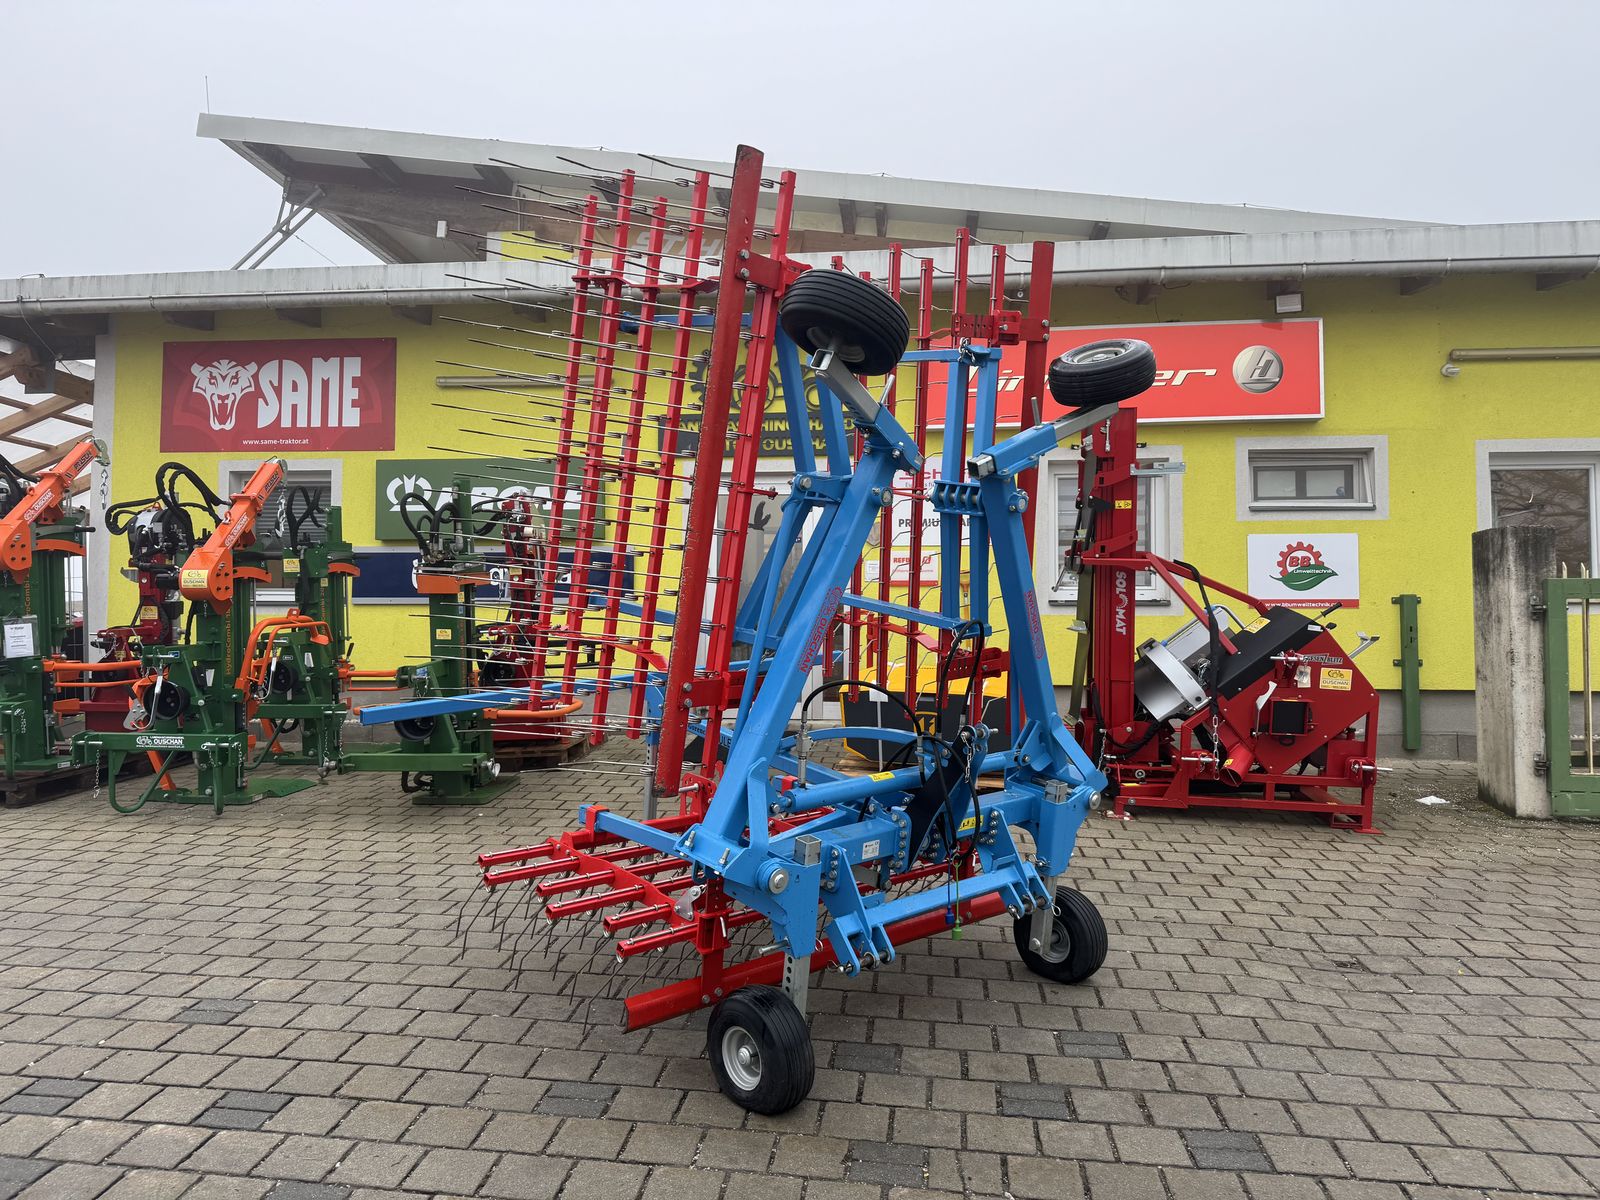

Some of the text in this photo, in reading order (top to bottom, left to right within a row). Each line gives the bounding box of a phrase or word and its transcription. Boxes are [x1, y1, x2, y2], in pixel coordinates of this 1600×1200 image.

[257, 356, 362, 428] SAME
[242, 438, 309, 446] www.same-traktor.at
[1288, 556, 1311, 567] BB
[800, 618, 827, 673] OUSCHAN
